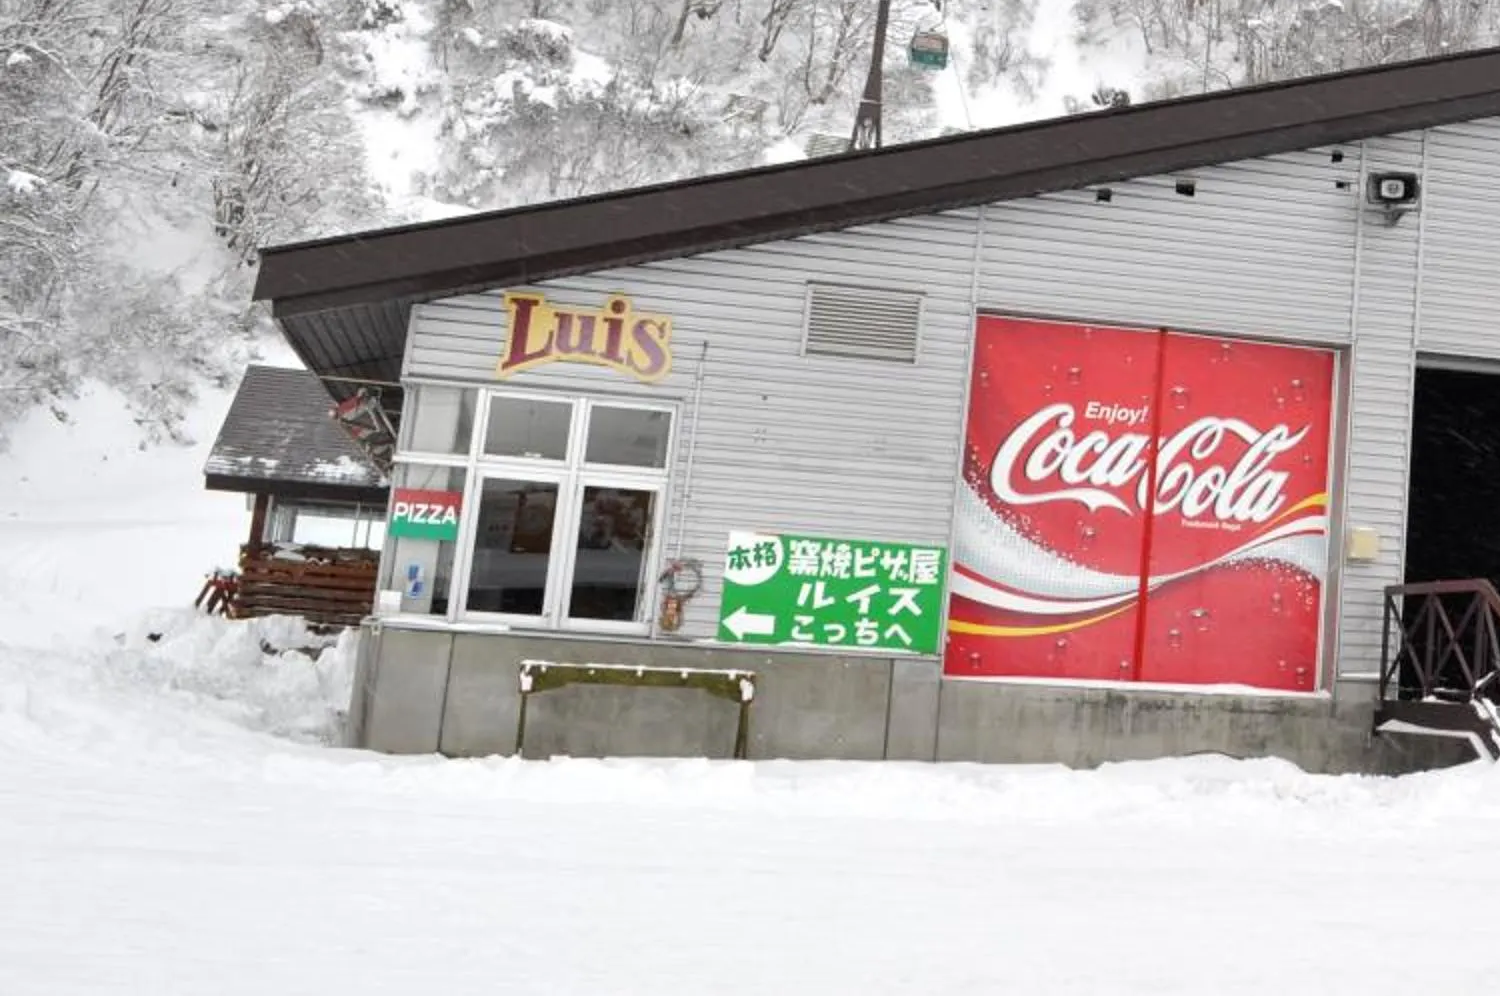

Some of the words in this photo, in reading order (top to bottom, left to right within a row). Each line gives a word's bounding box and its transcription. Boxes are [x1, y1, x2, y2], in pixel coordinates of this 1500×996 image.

[502, 296, 671, 376] Luis
[1085, 400, 1149, 426] Enjoy!
[393, 502, 457, 525] PIZZA
[728, 541, 777, 570] 本格
[797, 580, 923, 617] ルイス
[791, 614, 913, 646] こっちへ
